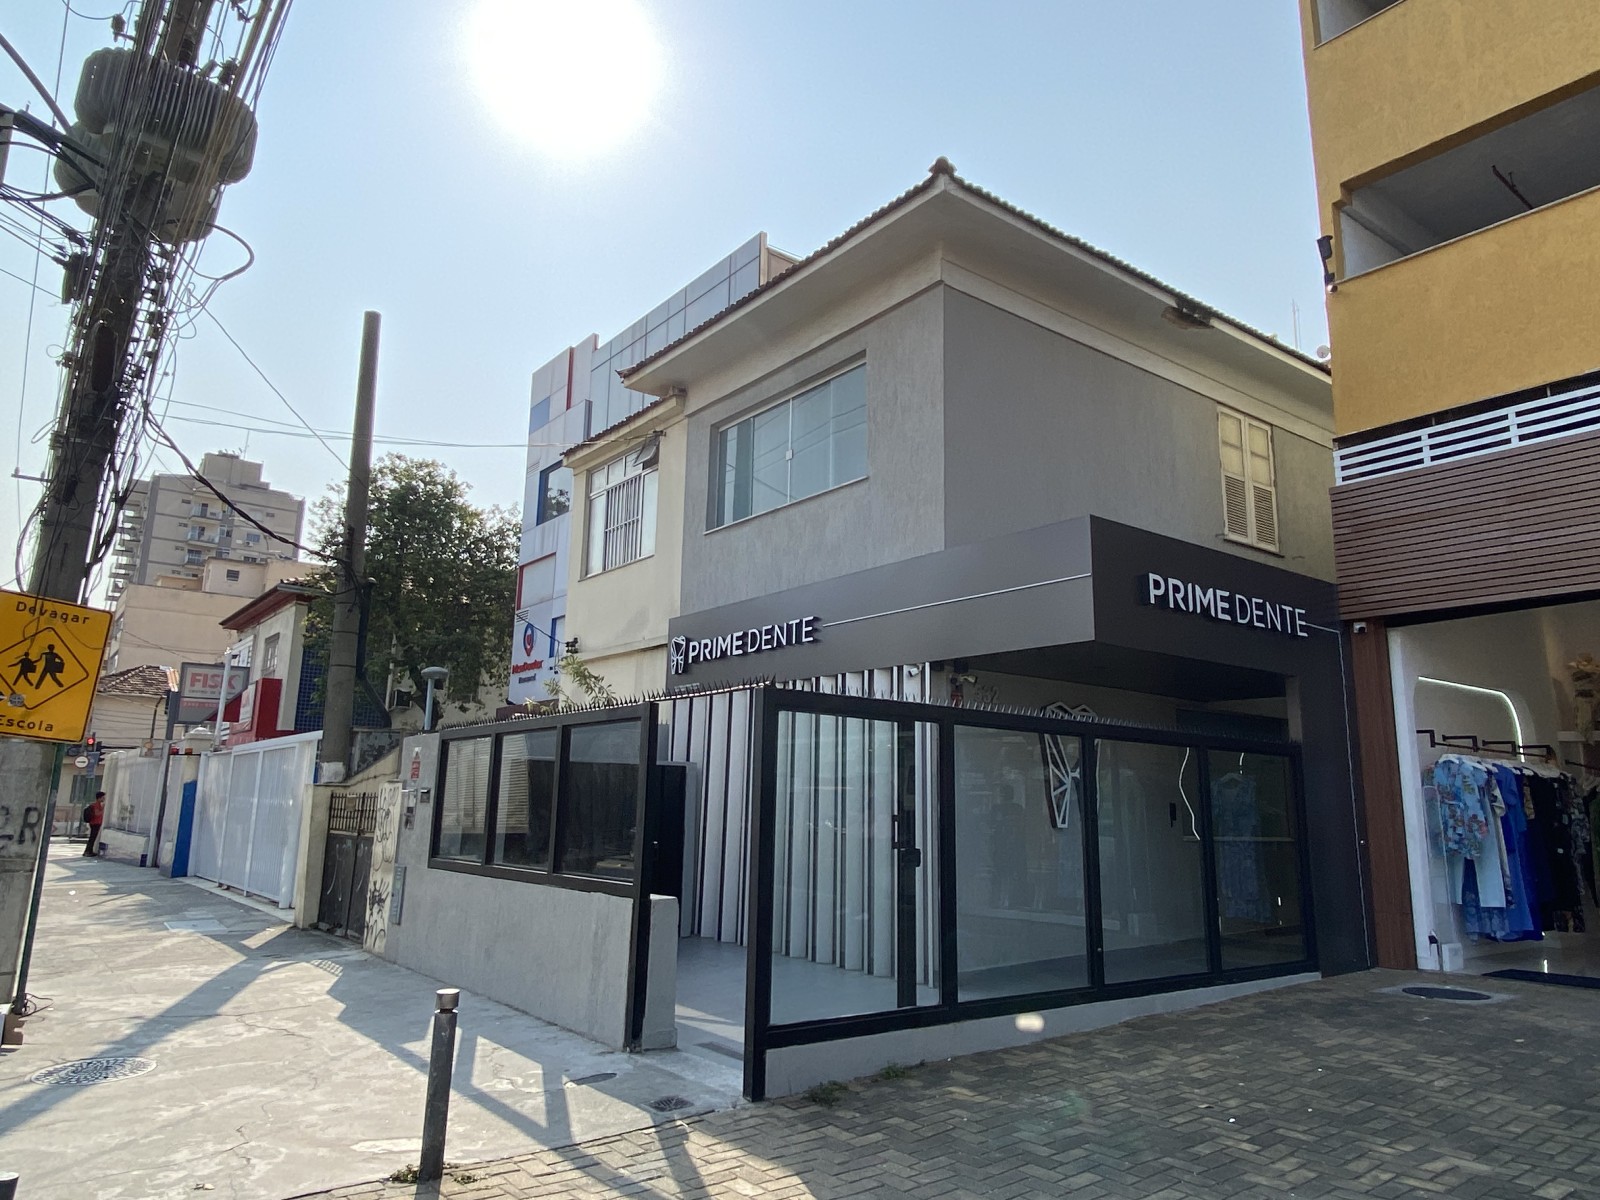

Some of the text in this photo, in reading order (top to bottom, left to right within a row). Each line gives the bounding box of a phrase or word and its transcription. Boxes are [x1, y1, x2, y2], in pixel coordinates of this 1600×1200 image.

[15, 601, 90, 624] Devagar
[1148, 572, 1309, 637] PRIME DENTE
[688, 615, 815, 664] PRIME DENTE
